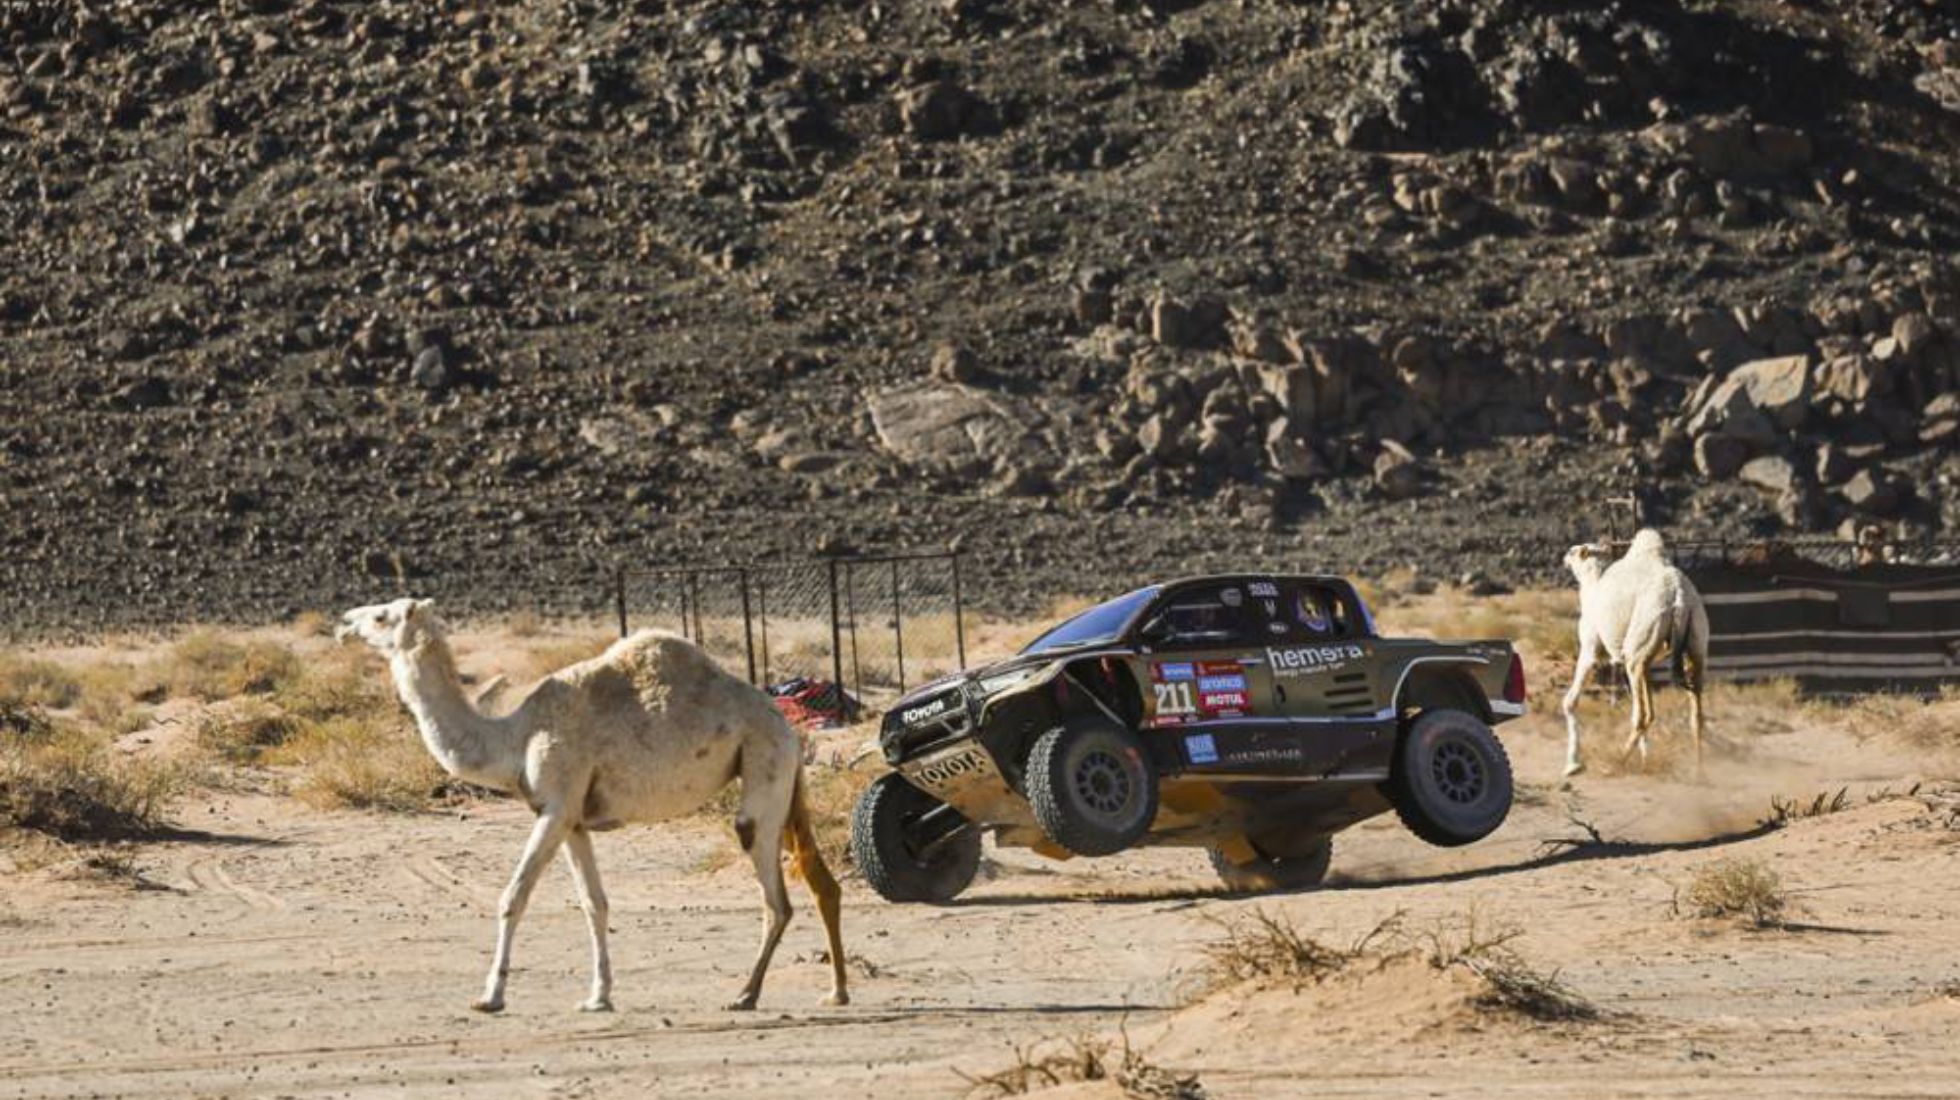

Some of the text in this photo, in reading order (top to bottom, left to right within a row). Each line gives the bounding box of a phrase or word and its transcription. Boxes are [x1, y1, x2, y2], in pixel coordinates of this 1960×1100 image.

[902, 699, 944, 723] TOYOTA
[1153, 682, 1196, 714] 211
[1205, 692, 1245, 706] MOTUL
[914, 749, 986, 785] TOYOTA
